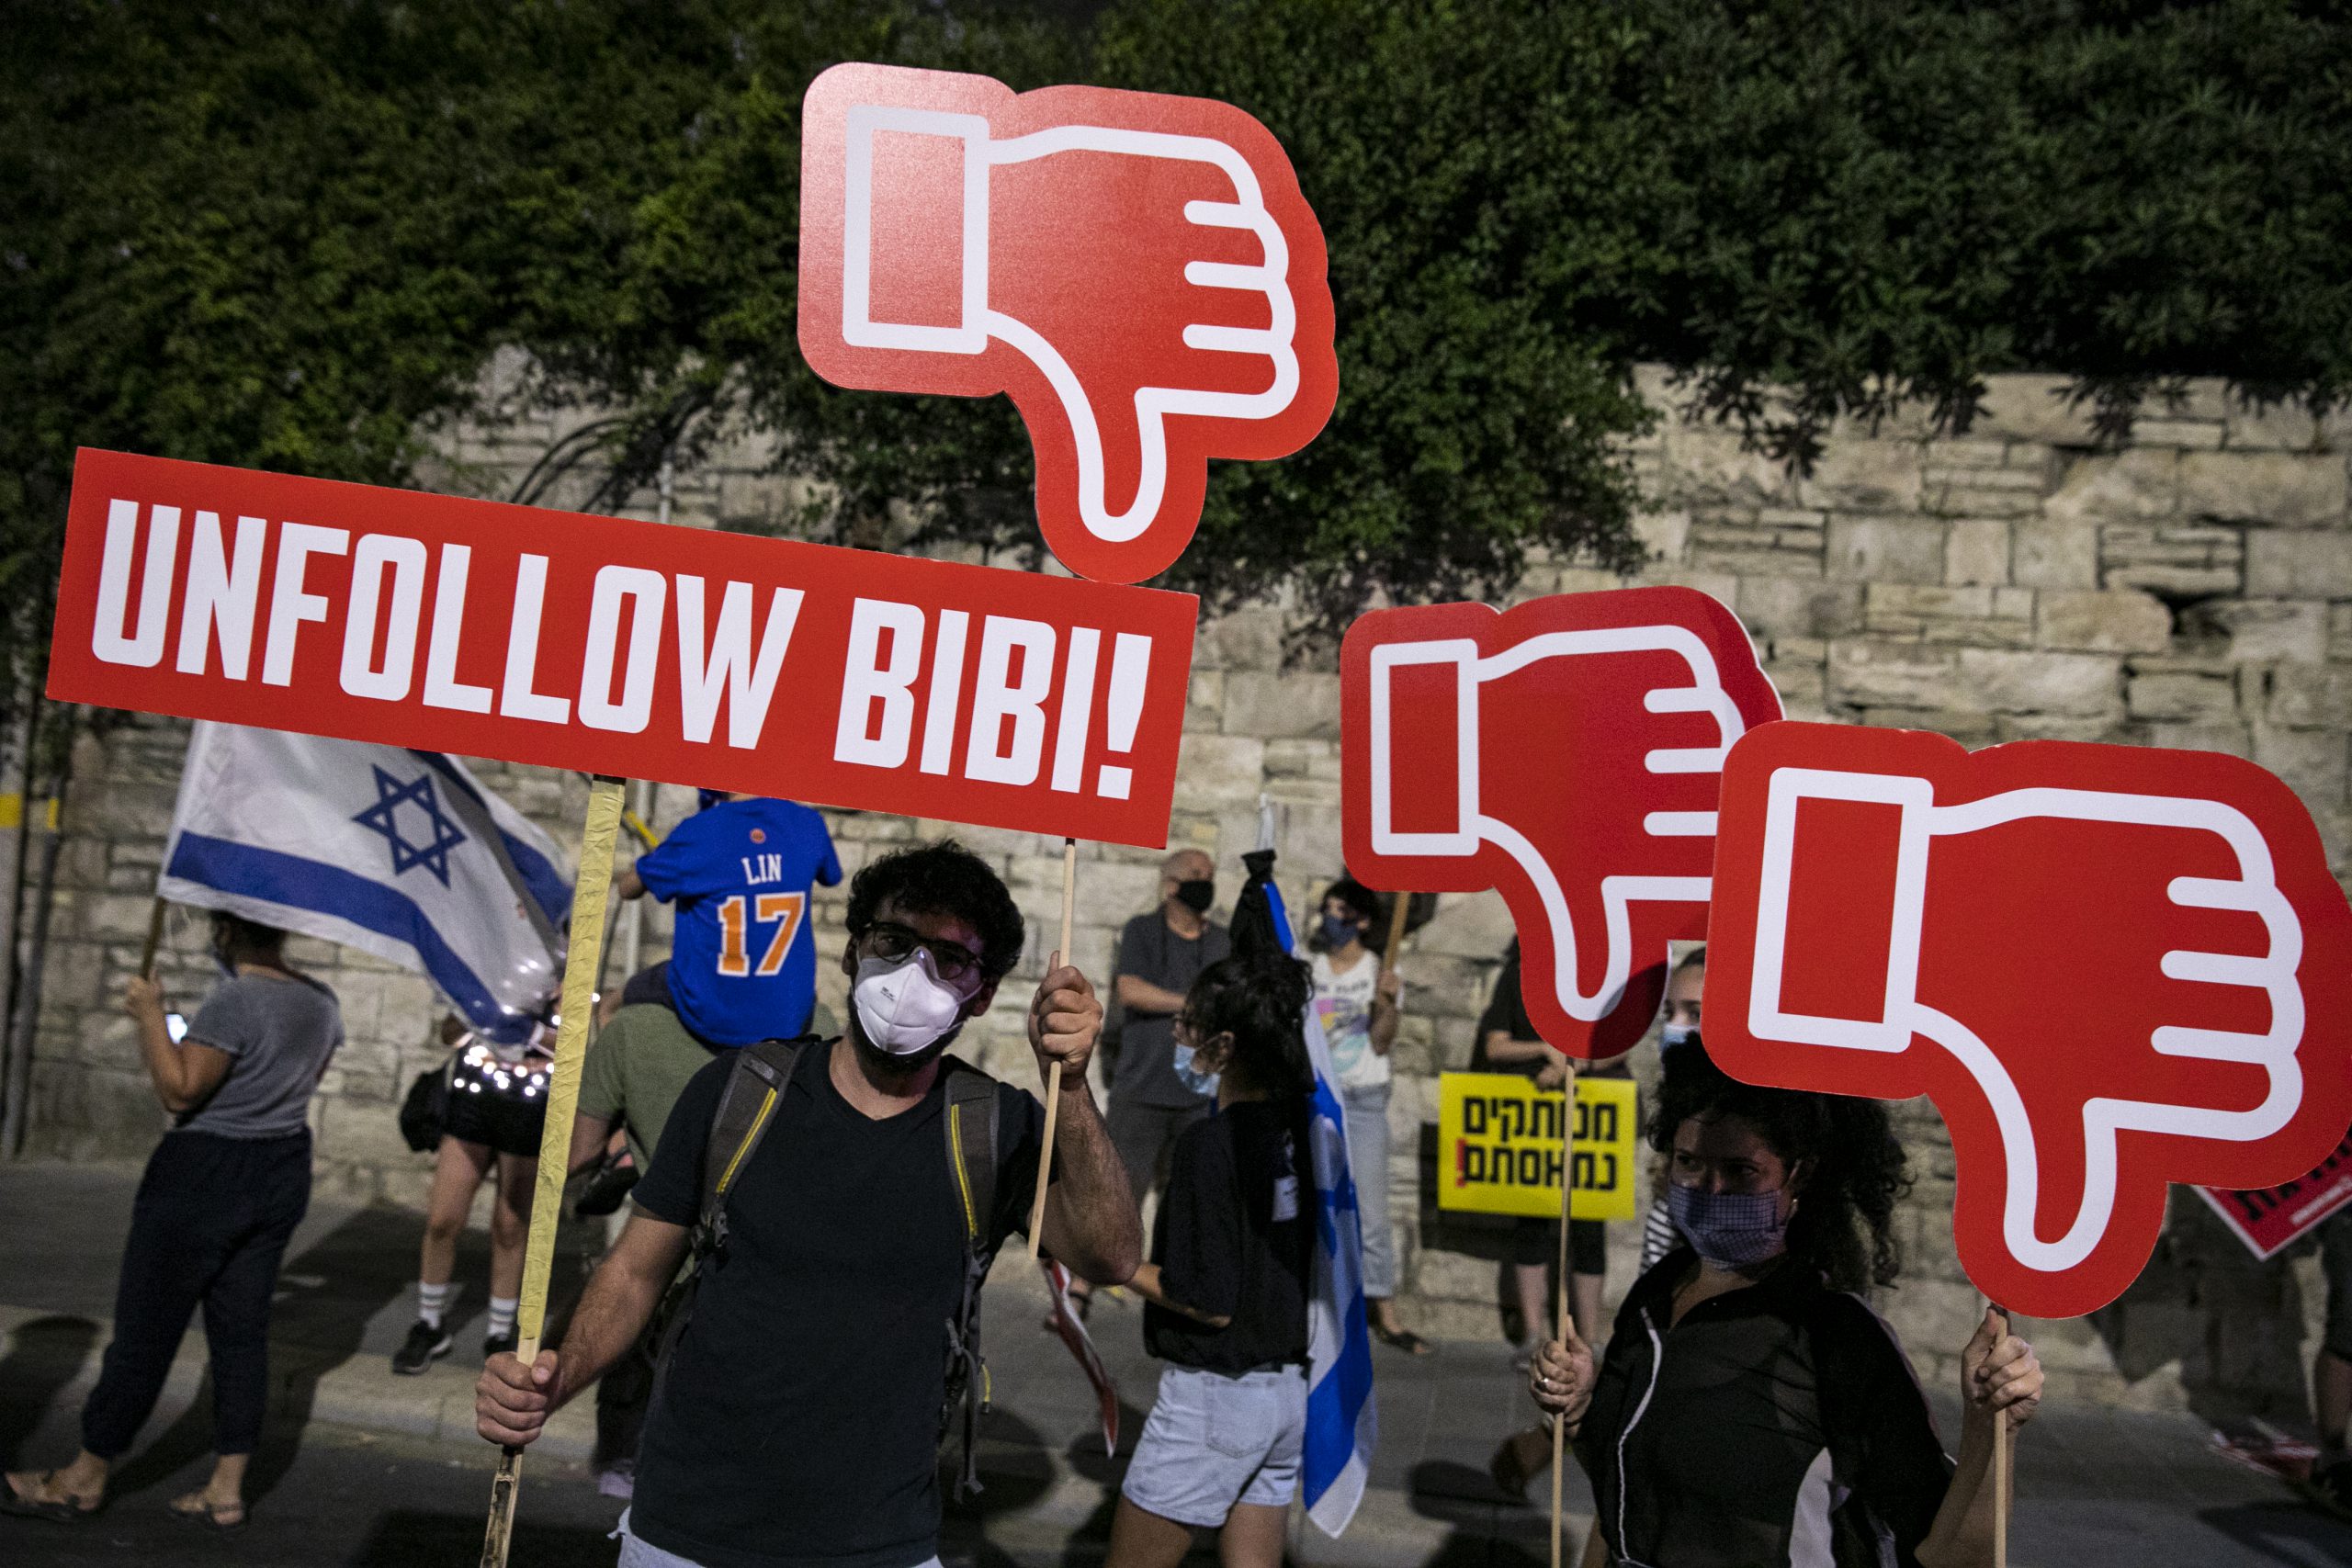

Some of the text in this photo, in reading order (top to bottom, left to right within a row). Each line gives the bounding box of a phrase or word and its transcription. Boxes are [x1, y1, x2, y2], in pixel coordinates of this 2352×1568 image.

[92, 499, 1152, 800] UNFOLLOW BIBI!
[741, 853, 782, 885] LIN
[717, 891, 805, 977] 17
[1456, 1137, 1617, 1191] נמאסתם!
